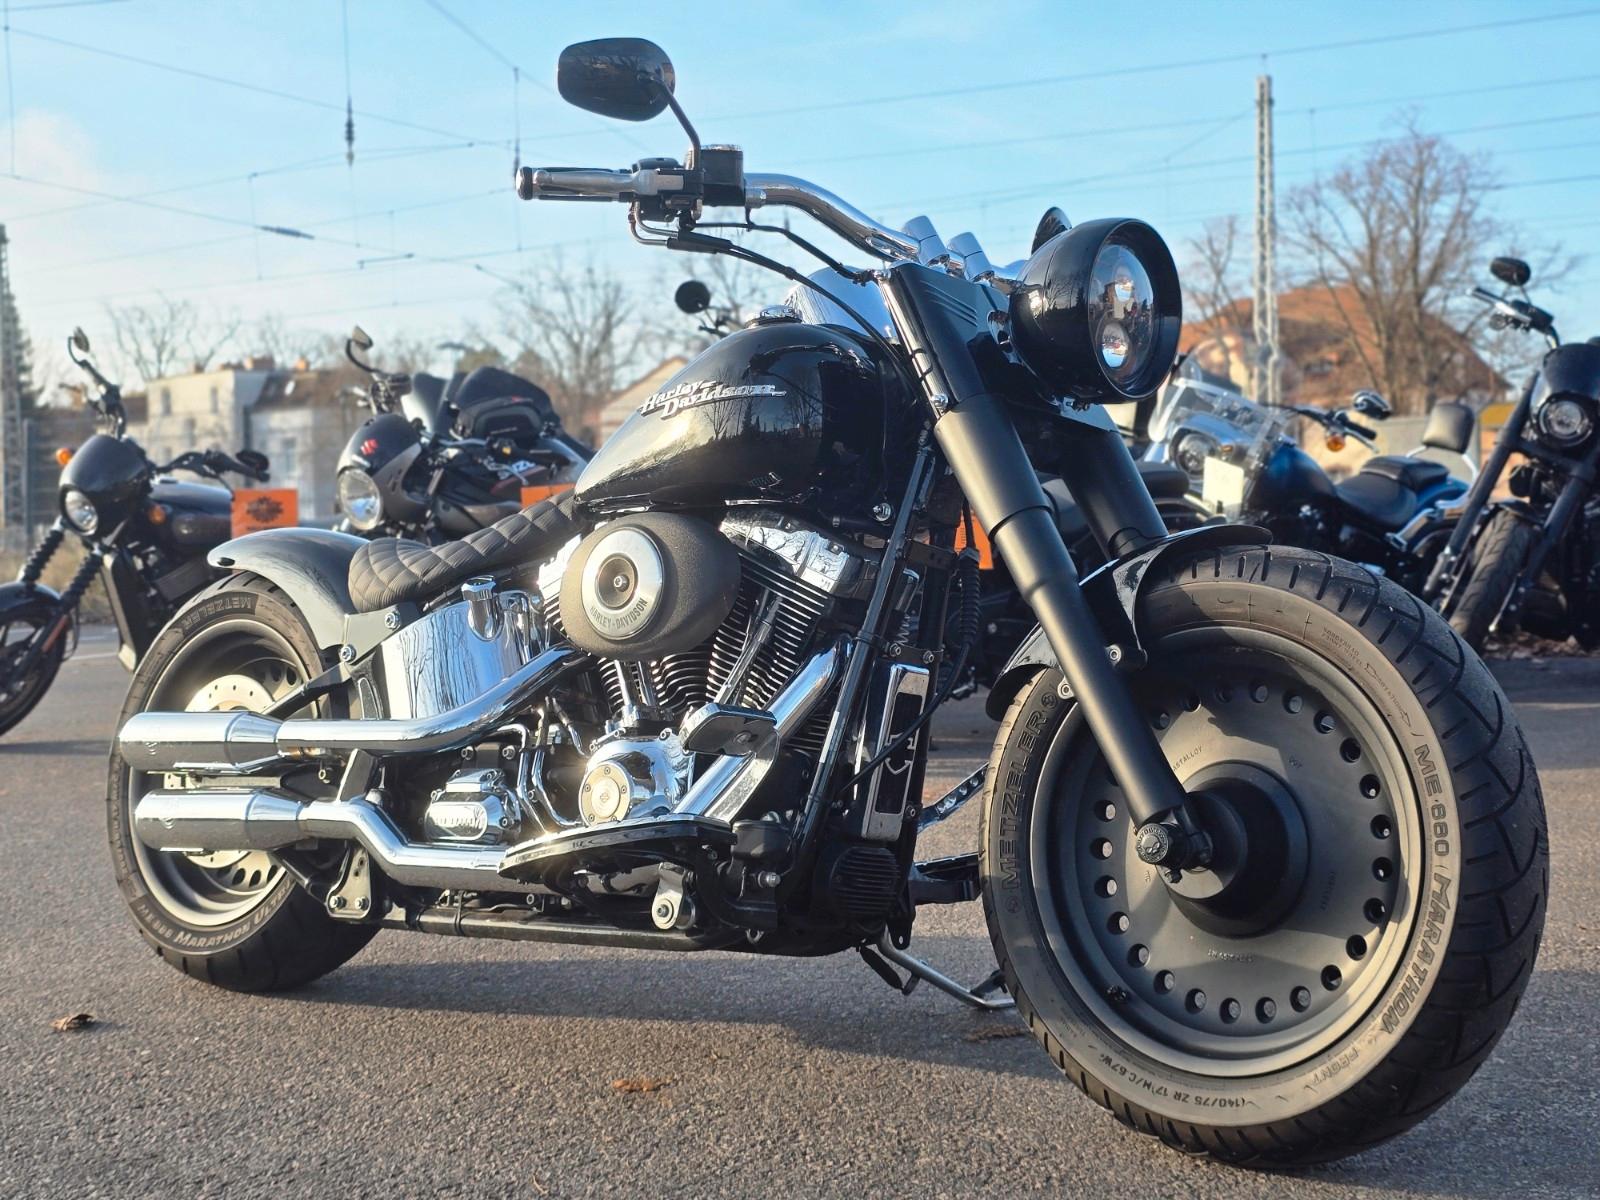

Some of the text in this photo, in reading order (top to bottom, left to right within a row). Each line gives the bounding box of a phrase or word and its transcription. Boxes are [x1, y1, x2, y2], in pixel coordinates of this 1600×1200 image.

[660, 384, 787, 421] Davidson
[181, 595, 252, 630] METZELER
[589, 597, 648, 630] HARLEY-DAVIDSON
[1172, 745, 1204, 771] ASTALLOY
[1413, 743, 1443, 798] ME
[1000, 710, 1049, 890] METZELER
[174, 923, 250, 948] MARATHON
[1382, 872, 1452, 1034] MARATHON
[1173, 1090, 1191, 1104] ZR
